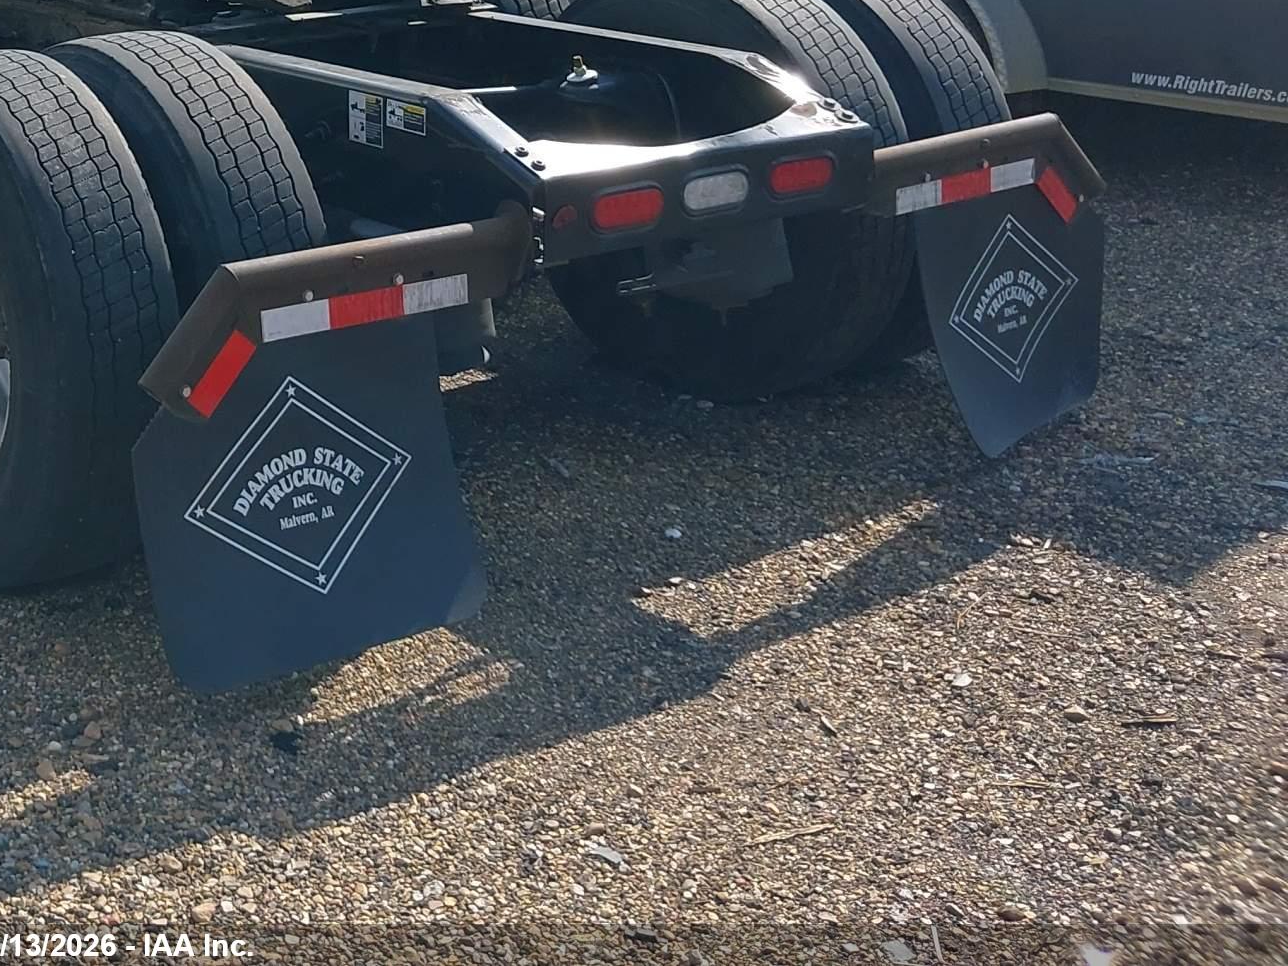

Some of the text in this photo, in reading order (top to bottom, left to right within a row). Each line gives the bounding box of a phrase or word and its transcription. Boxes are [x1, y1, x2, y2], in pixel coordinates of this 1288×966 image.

[973, 269, 1048, 323] DIAMOND STATE
[987, 285, 1035, 318] TRUCKING
[232, 446, 365, 517] DIAMOND STATE
[259, 467, 345, 511] TRUCKING
[292, 492, 318, 509] INC.
[279, 505, 335, 531] Malvern, AR
